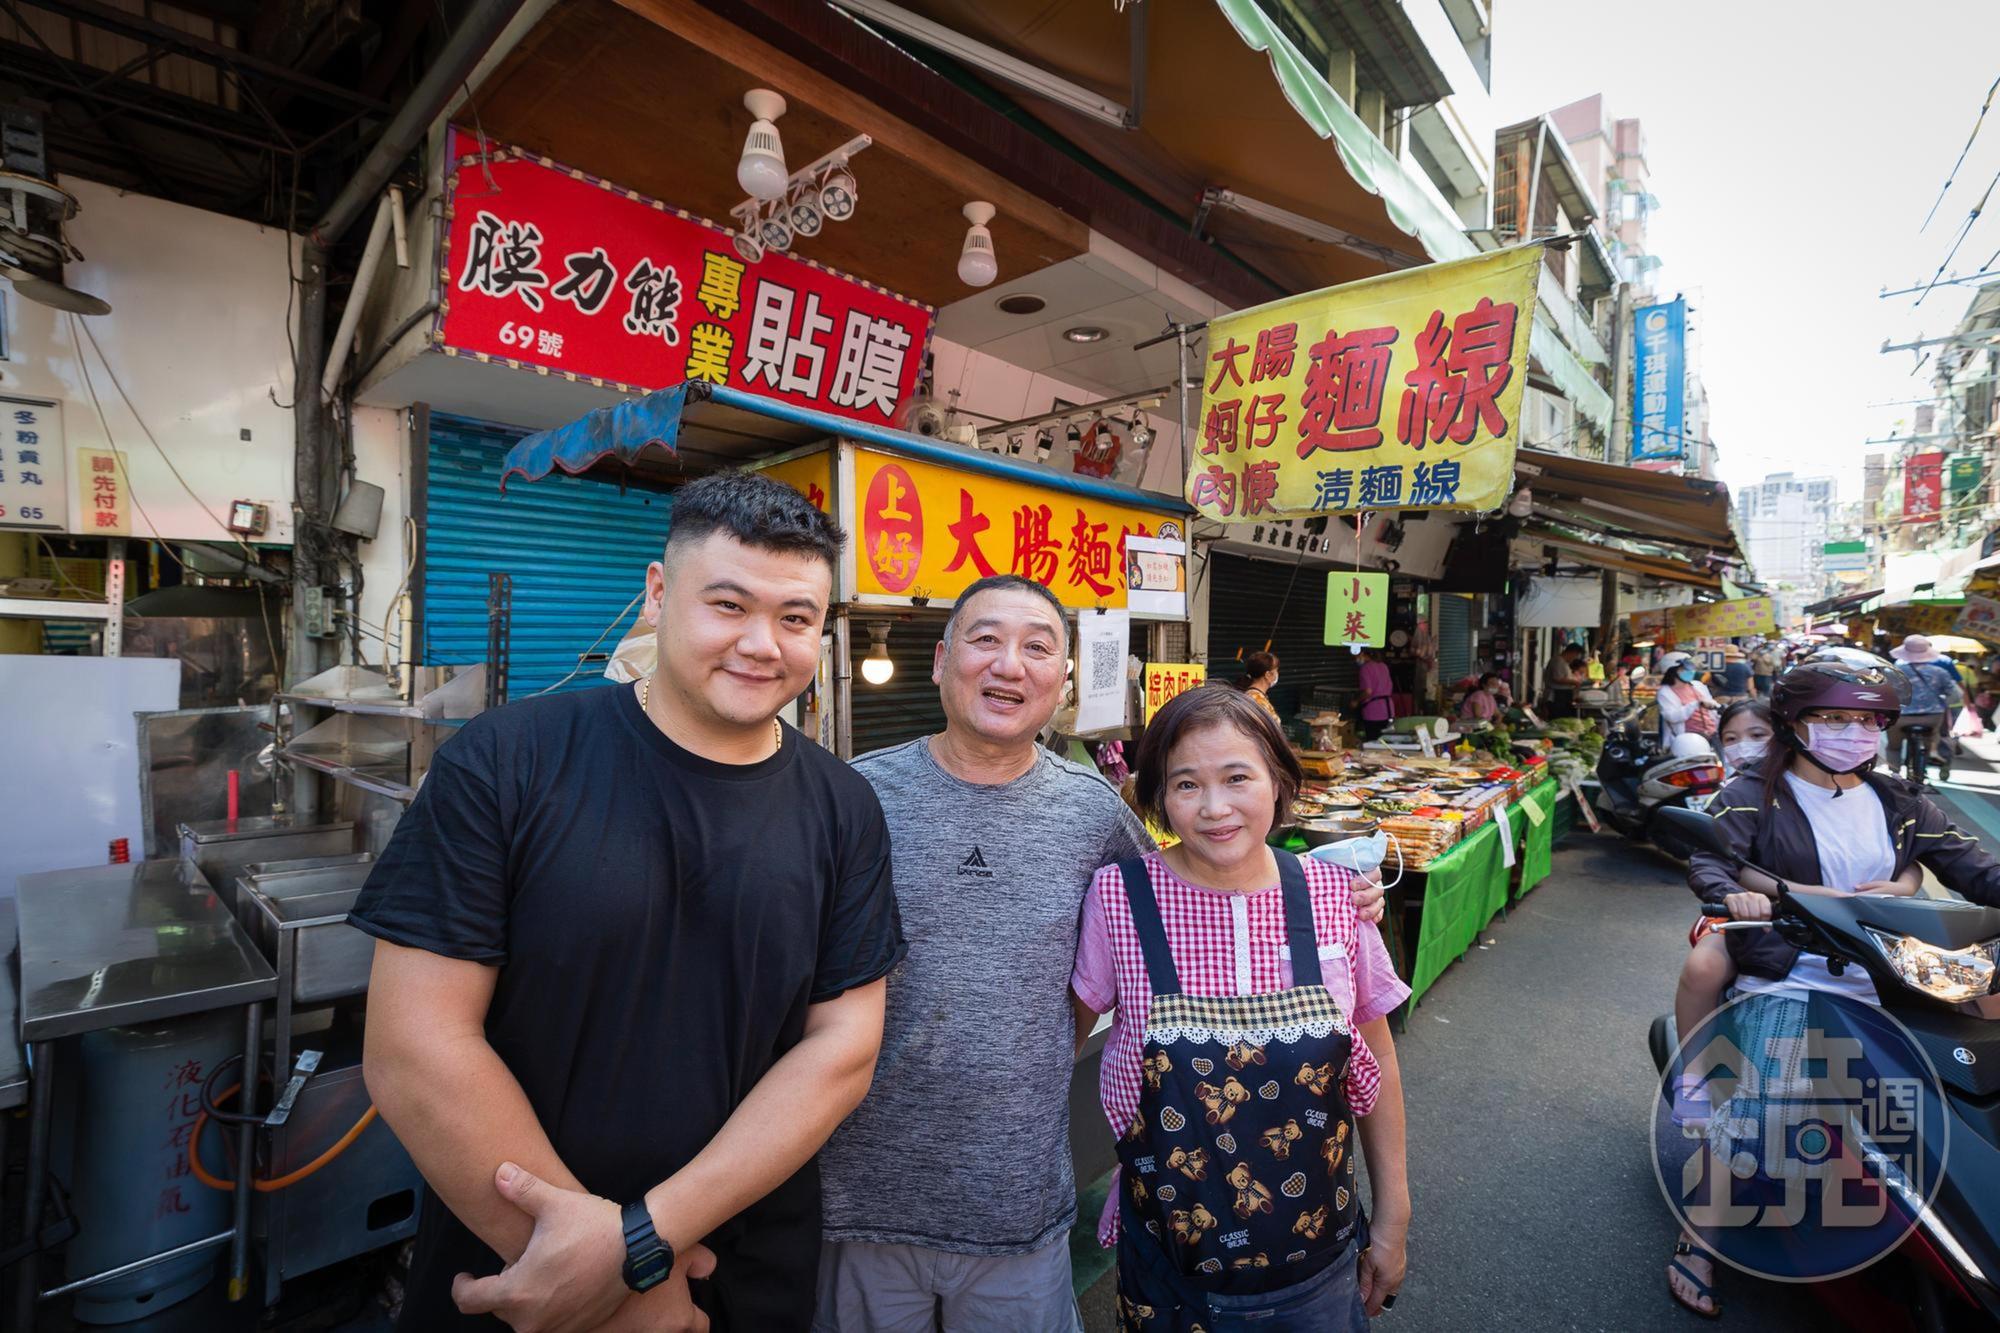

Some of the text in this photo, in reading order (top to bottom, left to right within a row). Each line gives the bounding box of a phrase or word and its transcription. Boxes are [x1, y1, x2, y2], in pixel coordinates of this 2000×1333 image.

[458, 211, 682, 347] 膜力熊
[685, 249, 746, 386] 專業
[741, 278, 912, 419] 貼膜
[1209, 322, 1298, 394] 大腸
[1296, 297, 1518, 460] 麵線
[1201, 393, 1287, 455] 蚵仔
[20, 506, 43, 520] 65
[91, 456, 118, 528] 請先付款
[873, 473, 915, 580] 上好
[1342, 577, 1372, 641] 小菜
[1219, 1229, 1249, 1243] CLASSIC
